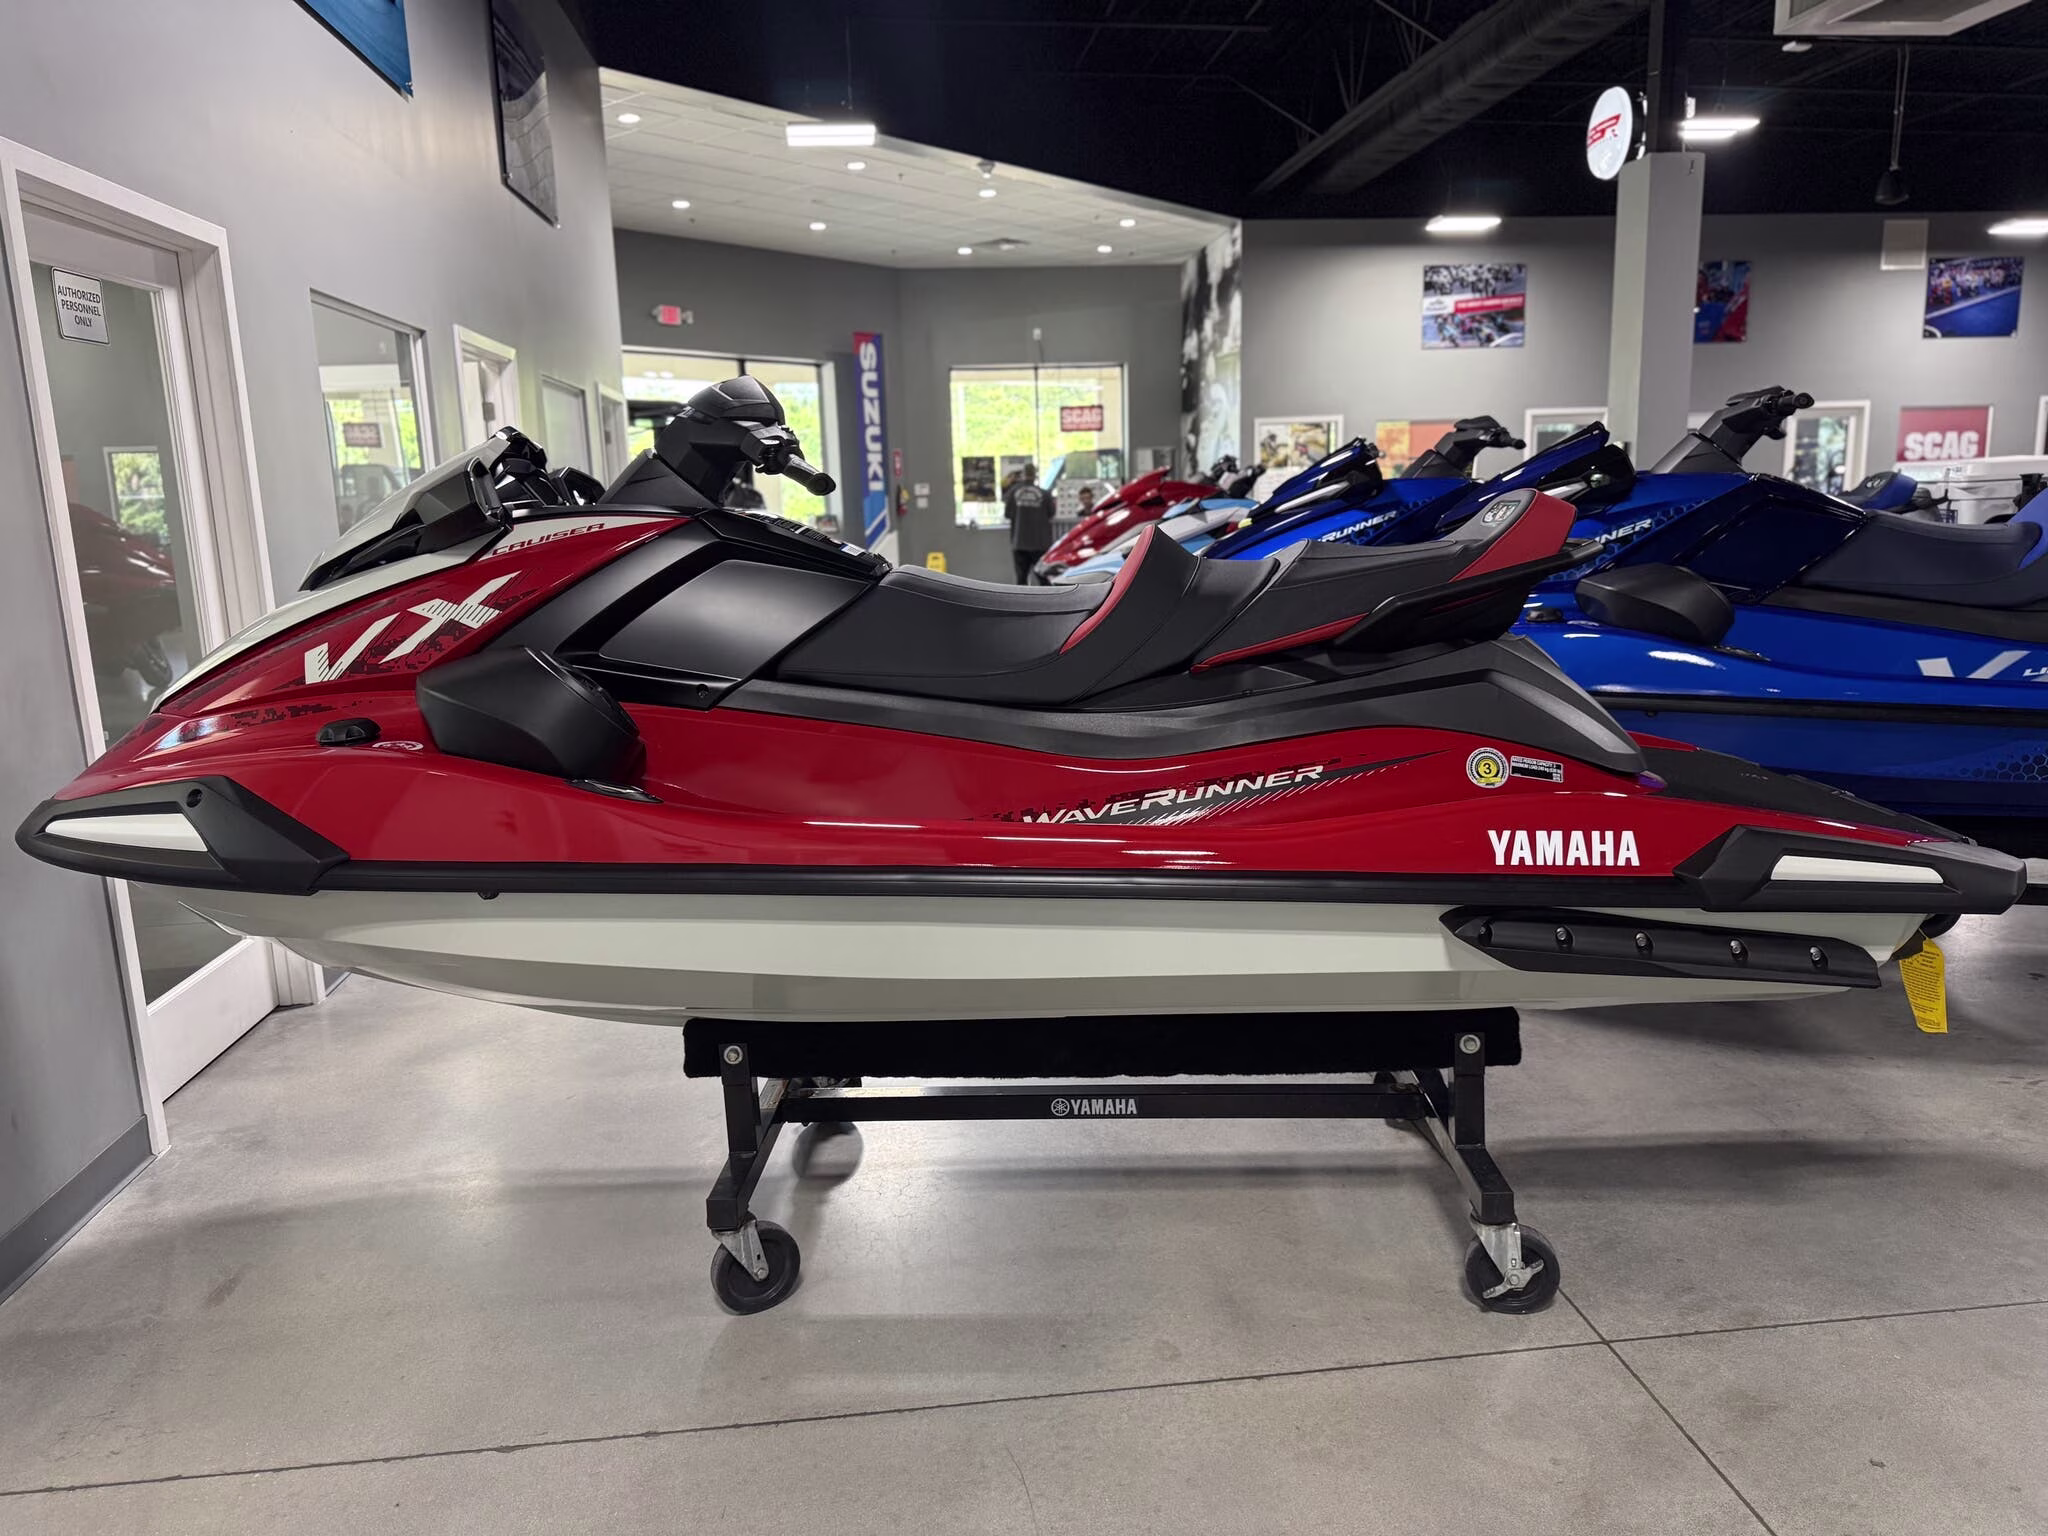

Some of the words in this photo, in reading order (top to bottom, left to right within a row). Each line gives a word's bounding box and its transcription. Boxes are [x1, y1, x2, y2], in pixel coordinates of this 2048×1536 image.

[58, 285, 101, 303] AUTHORIZED
[61, 299, 101, 316] PERSONNEL
[75, 314, 92, 327] ONLY
[860, 342, 885, 491] SUZUKI
[1903, 430, 1979, 460] SCAG
[492, 522, 605, 556] CRUISER
[1318, 510, 1397, 542] RUNNER
[304, 570, 522, 685] VX
[1482, 762, 1493, 775] 3
[1487, 829, 1640, 867] YAMAHA
[1070, 1098, 1138, 1115] YAMAHA
